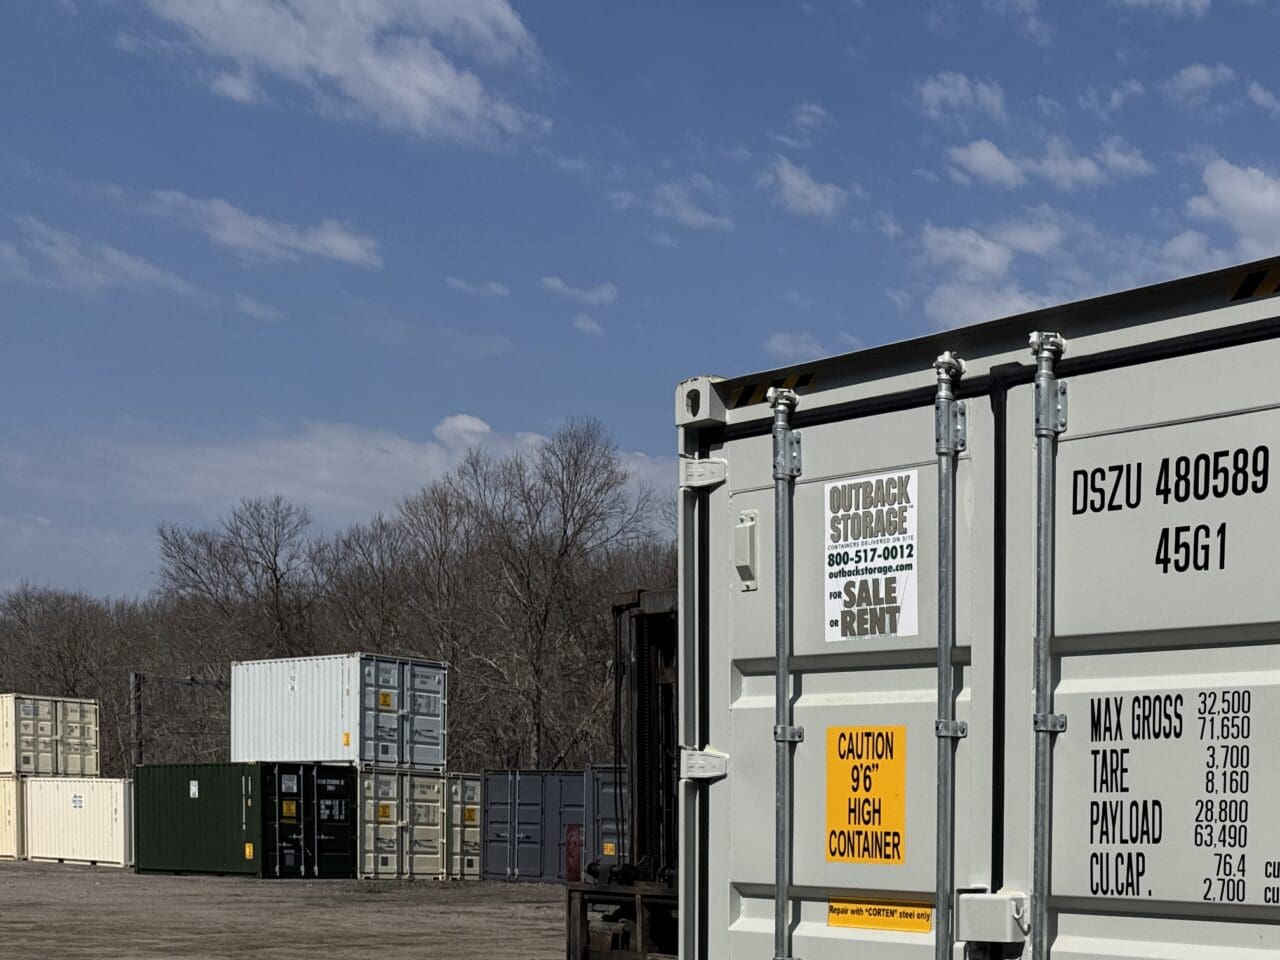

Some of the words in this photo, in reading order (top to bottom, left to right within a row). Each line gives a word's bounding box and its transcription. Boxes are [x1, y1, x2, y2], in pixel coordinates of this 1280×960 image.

[1072, 462, 1142, 515] DSZU
[1155, 445, 1270, 505] 480589
[829, 475, 911, 514] OUTBACK
[830, 505, 908, 544] STORAGE
[828, 542, 859, 551] CONTAINERS
[861, 538, 890, 547] DELIVERED
[828, 543, 914, 567] 800-517-0012
[1155, 522, 1227, 574] 45G1
[828, 563, 913, 579] outbackstorage.com
[829, 591, 842, 600] FOR
[843, 576, 897, 609] SALE
[829, 619, 839, 628] OR
[840, 605, 900, 638] RENT
[1090, 696, 1124, 742] MAX
[1131, 693, 1184, 740] GROSS
[1198, 690, 1251, 715] 32,500
[1197, 715, 1251, 741] 71,650
[838, 732, 894, 760] CAUTION
[1091, 748, 1130, 793] TARE
[1206, 745, 1250, 770] 3,700
[1205, 770, 1249, 795] 8,160
[848, 798, 881, 826] HIGH
[1089, 799, 1163, 845] PAYLOAD
[1195, 799, 1249, 824] 28,800
[829, 830, 901, 860] CONTAINER
[1194, 824, 1248, 849] 63,490
[1214, 853, 1246, 878] 76.4
[1203, 878, 1246, 903] 2,700
[829, 905, 848, 916] Repair
[850, 907, 864, 915] with
[899, 910, 915, 919] steel
[916, 911, 930, 922] only
